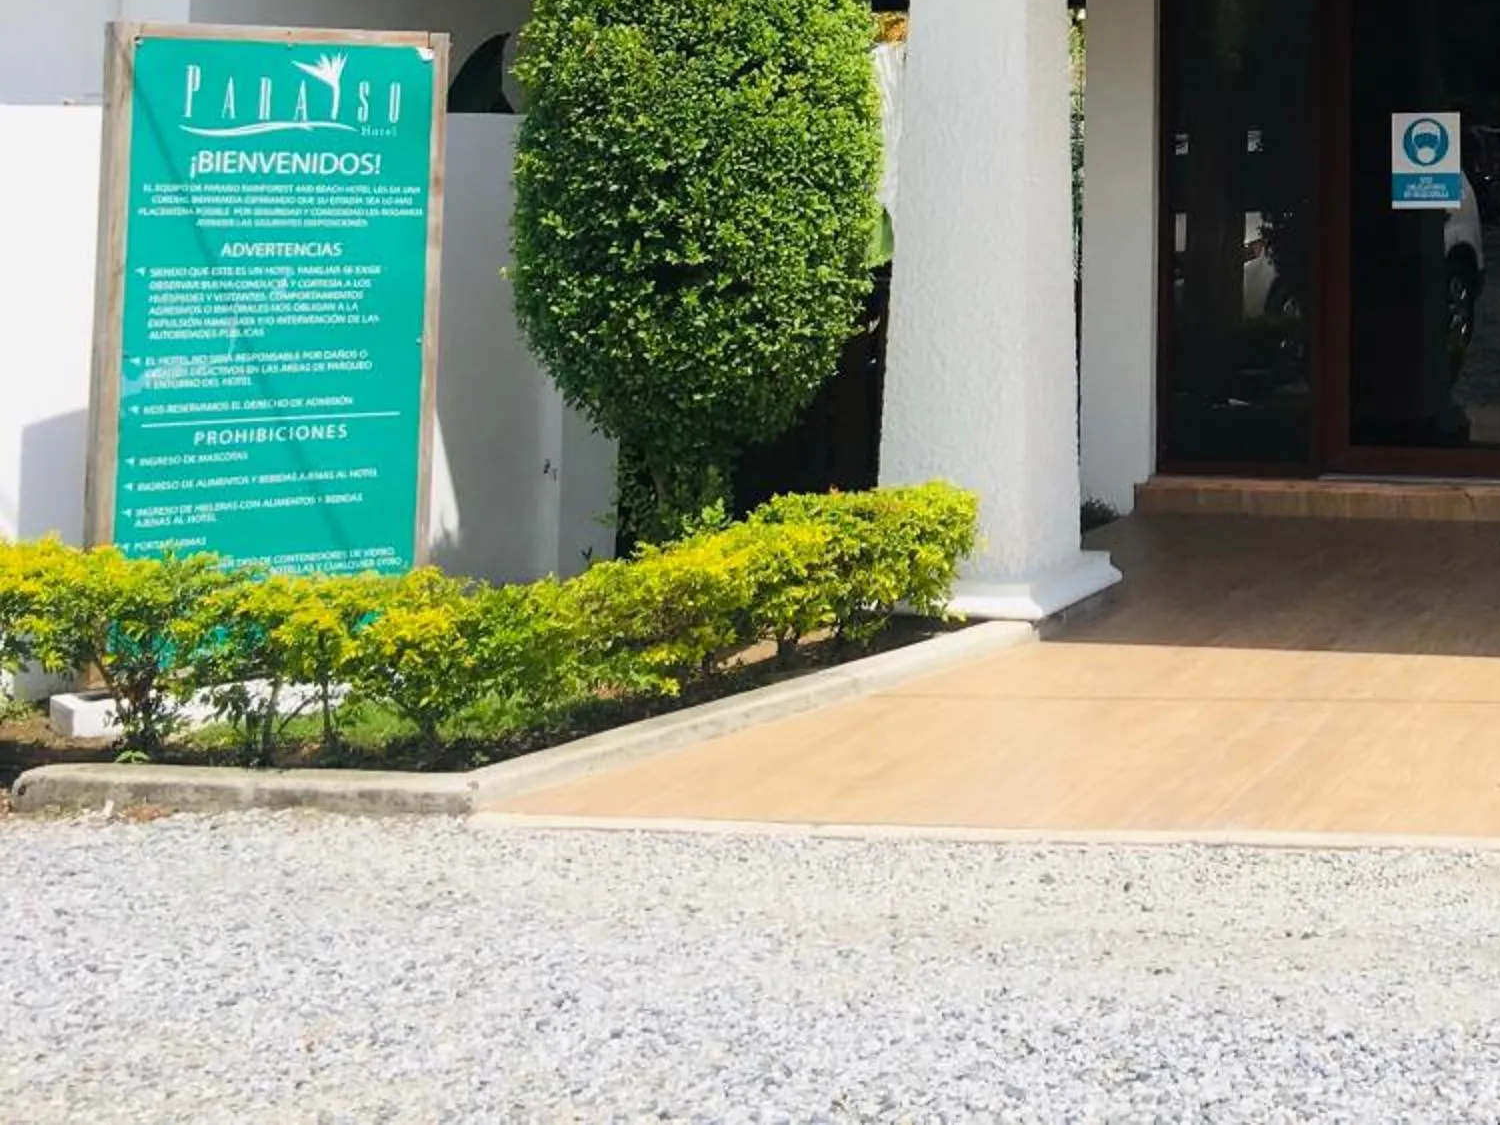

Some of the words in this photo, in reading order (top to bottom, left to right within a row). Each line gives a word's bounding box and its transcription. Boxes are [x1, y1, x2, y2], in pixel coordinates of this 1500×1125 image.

[189, 150, 382, 178] ¡BIENVENIDOS!
[220, 242, 343, 258] ADVERTENCIAS
[193, 424, 349, 446] PROHIBICIONES
